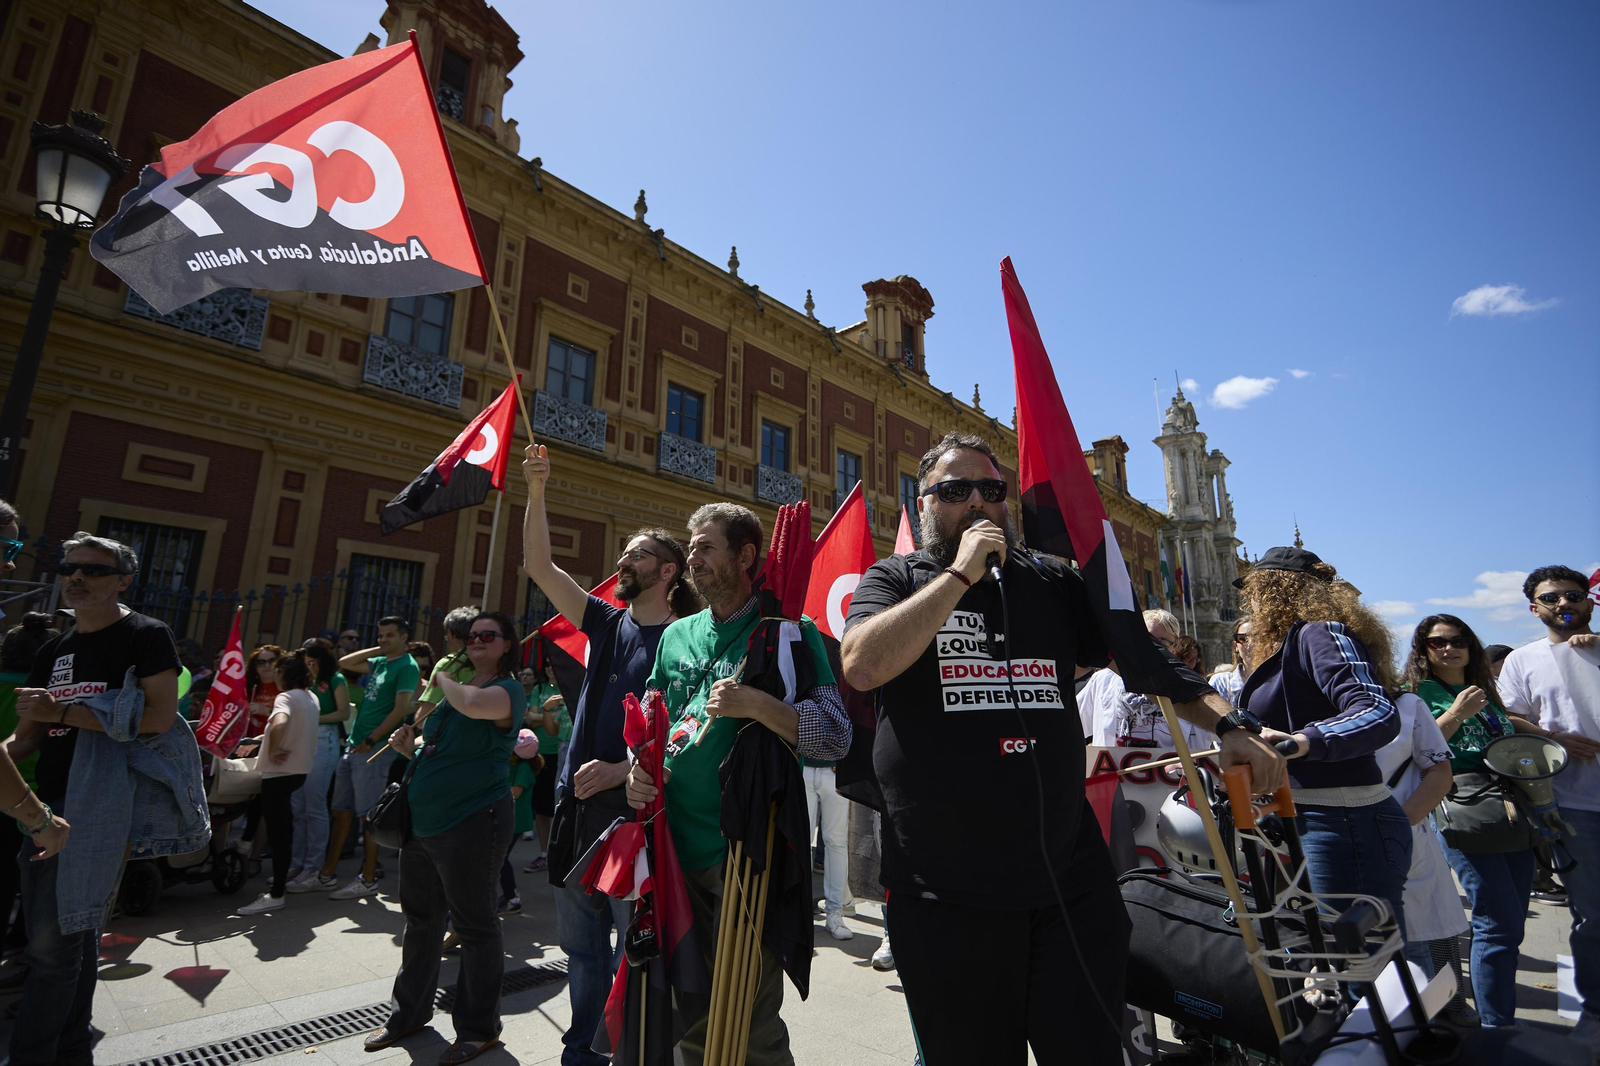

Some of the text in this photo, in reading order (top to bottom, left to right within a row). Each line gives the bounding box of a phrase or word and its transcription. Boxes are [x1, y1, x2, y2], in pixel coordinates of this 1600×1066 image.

[941, 660, 1056, 680] EDUCACIÓN
[945, 689, 1060, 706] DEFIENDES?
[49, 728, 71, 737] CGT
[666, 741, 681, 757] CGT
[1003, 738, 1037, 754] CGT
[1177, 994, 1220, 1014] BROMPTON
[1184, 1007, 1211, 1020] ELECTRIC
